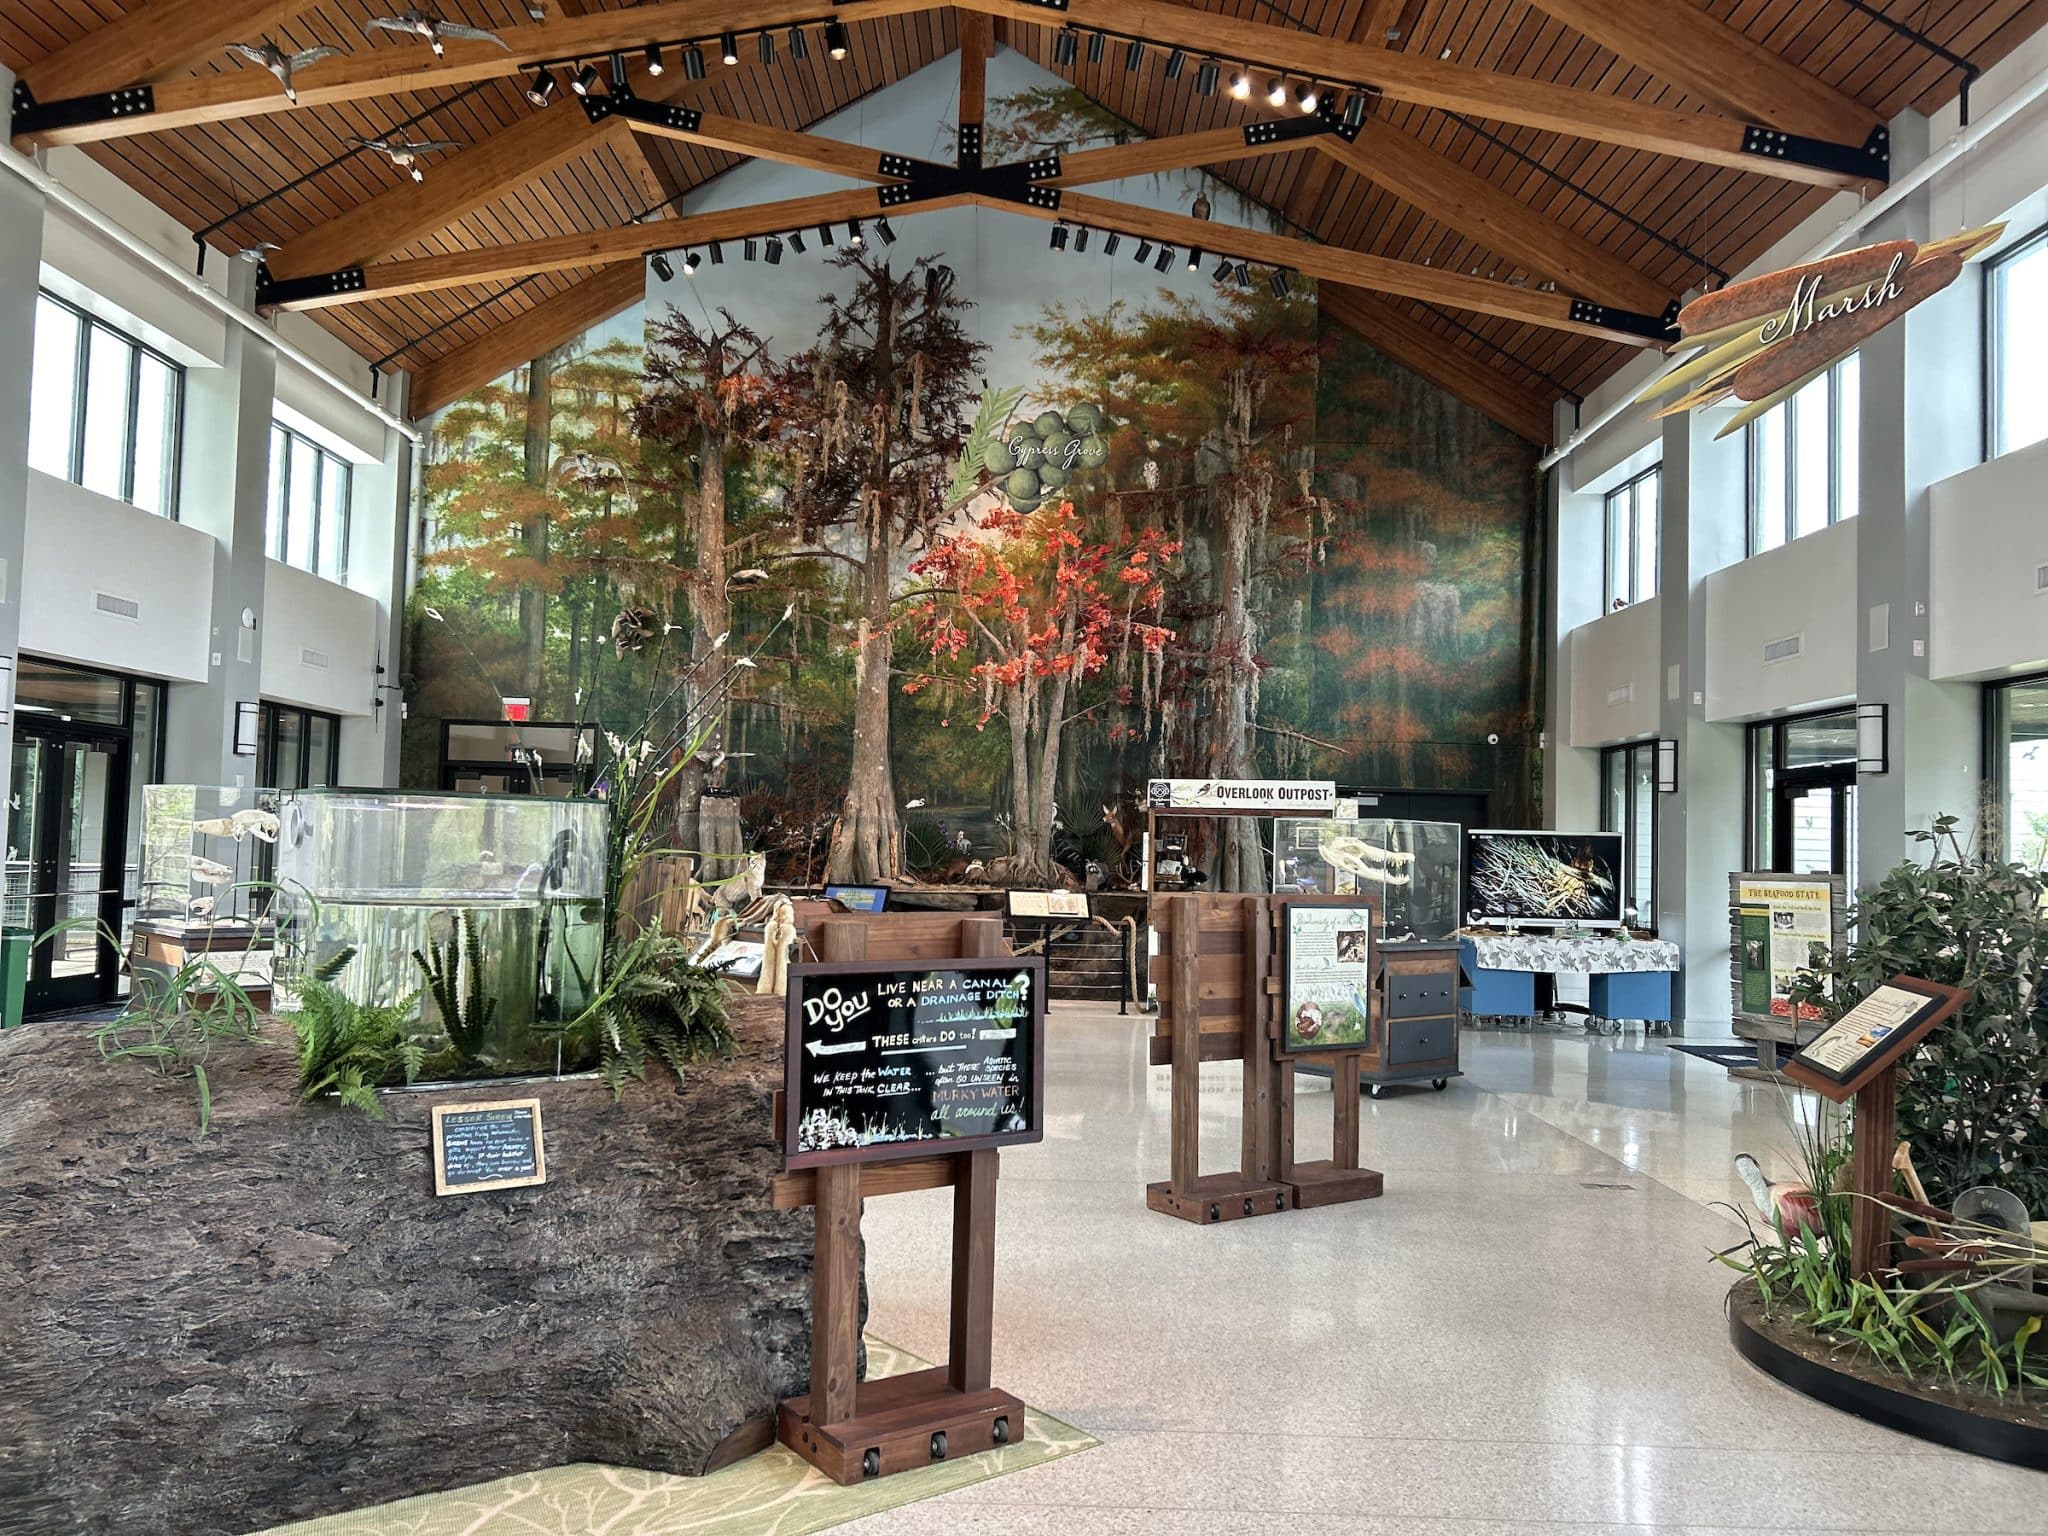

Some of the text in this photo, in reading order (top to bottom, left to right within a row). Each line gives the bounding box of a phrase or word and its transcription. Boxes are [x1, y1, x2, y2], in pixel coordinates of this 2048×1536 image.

[1759, 251, 1904, 344] Marsh
[1008, 436, 1103, 471] Cypress Grove
[1216, 786, 1330, 801] OVERLOOK OUTPOST
[1748, 888, 1821, 900] THE SEAFOOD STATE
[877, 981, 906, 996] LIVE
[912, 978, 943, 993] NEAR
[949, 979, 958, 989] A
[962, 978, 1012, 989] CANAL
[803, 987, 842, 1026] DO
[887, 997, 903, 1008] OR
[906, 999, 917, 1008] A
[921, 991, 981, 1006] DRAINAGE
[871, 1033, 910, 1048] THESE
[940, 1030, 956, 1042] DO
[813, 1065, 912, 1085] WE KEEP the WATER
[956, 1074, 967, 1083] GO
[970, 1072, 1004, 1082] UNSEEN
[1008, 1073, 1019, 1083] in
[822, 1087, 834, 1097] IN
[834, 1085, 852, 1095] THIS
[853, 1084, 875, 1094] TANK
[932, 1085, 1020, 1103] MURKY WATER
[930, 1103, 951, 1120] all
[954, 1101, 998, 1118] around
